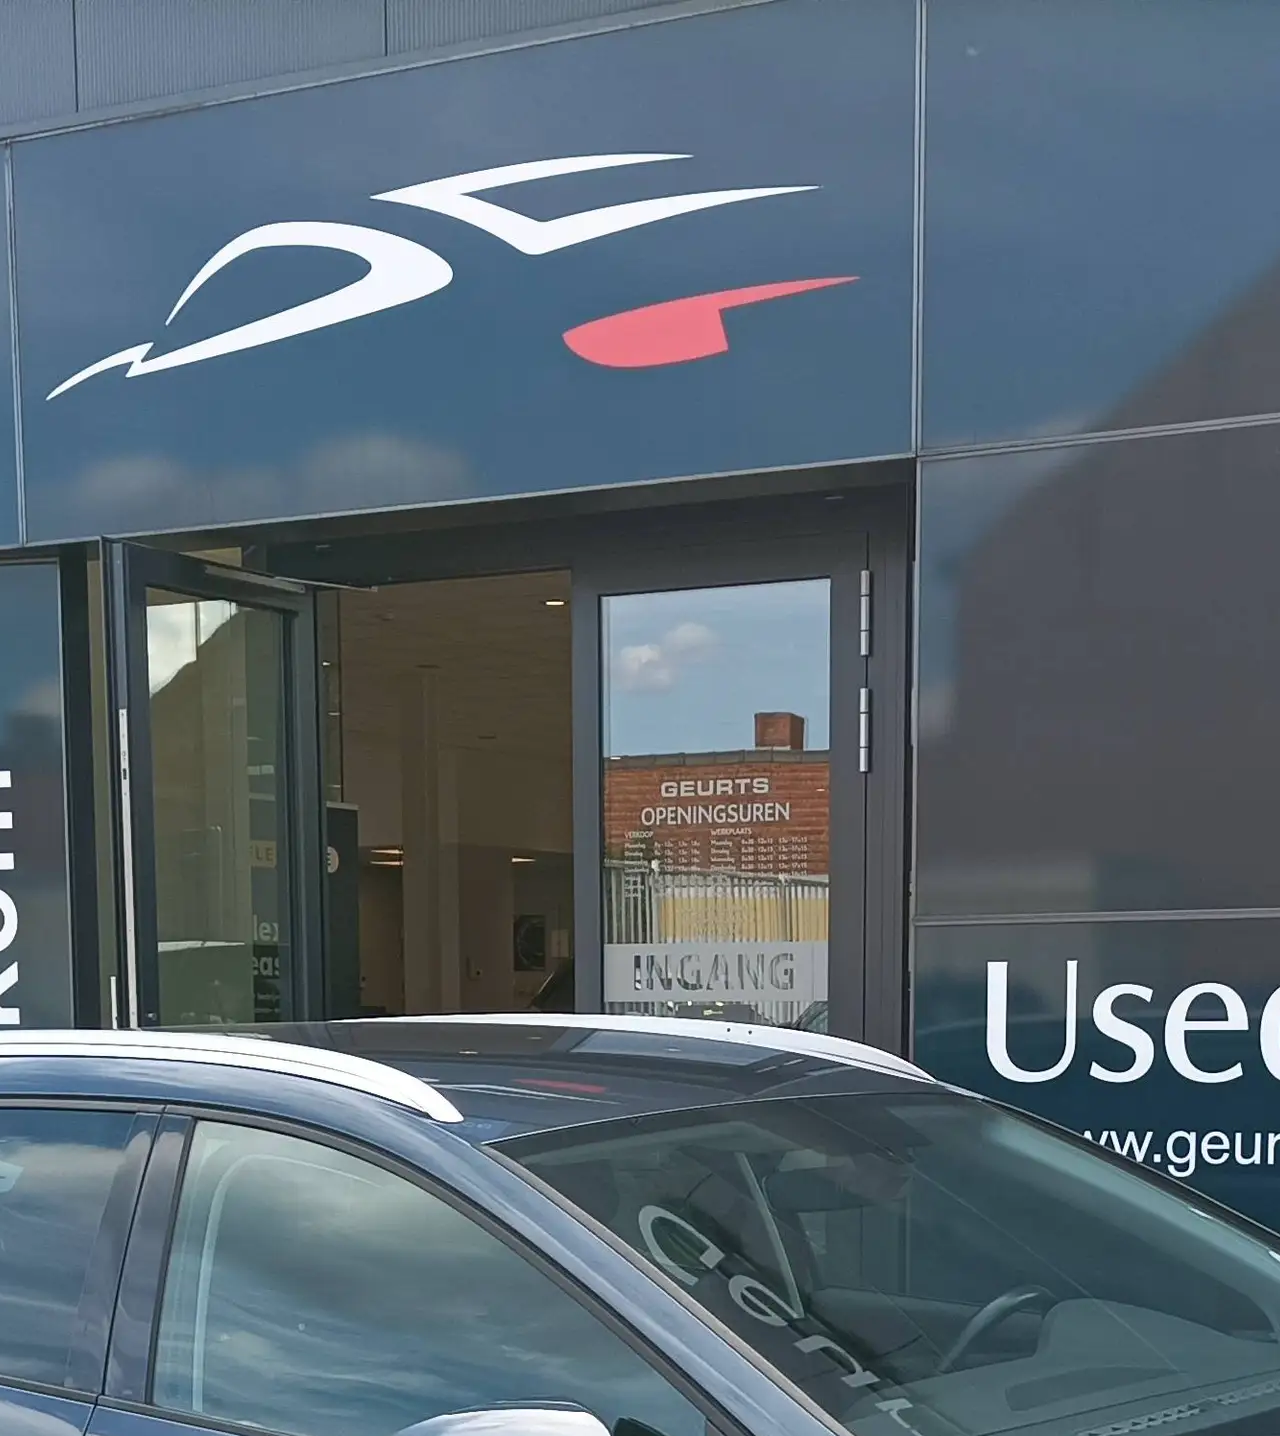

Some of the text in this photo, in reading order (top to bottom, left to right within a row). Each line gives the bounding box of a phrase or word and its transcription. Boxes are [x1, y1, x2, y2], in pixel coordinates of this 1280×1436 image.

[661, 777, 769, 798] GEURTS
[641, 802, 790, 826] OPENINGSUREN
[633, 952, 795, 991] INGANG
